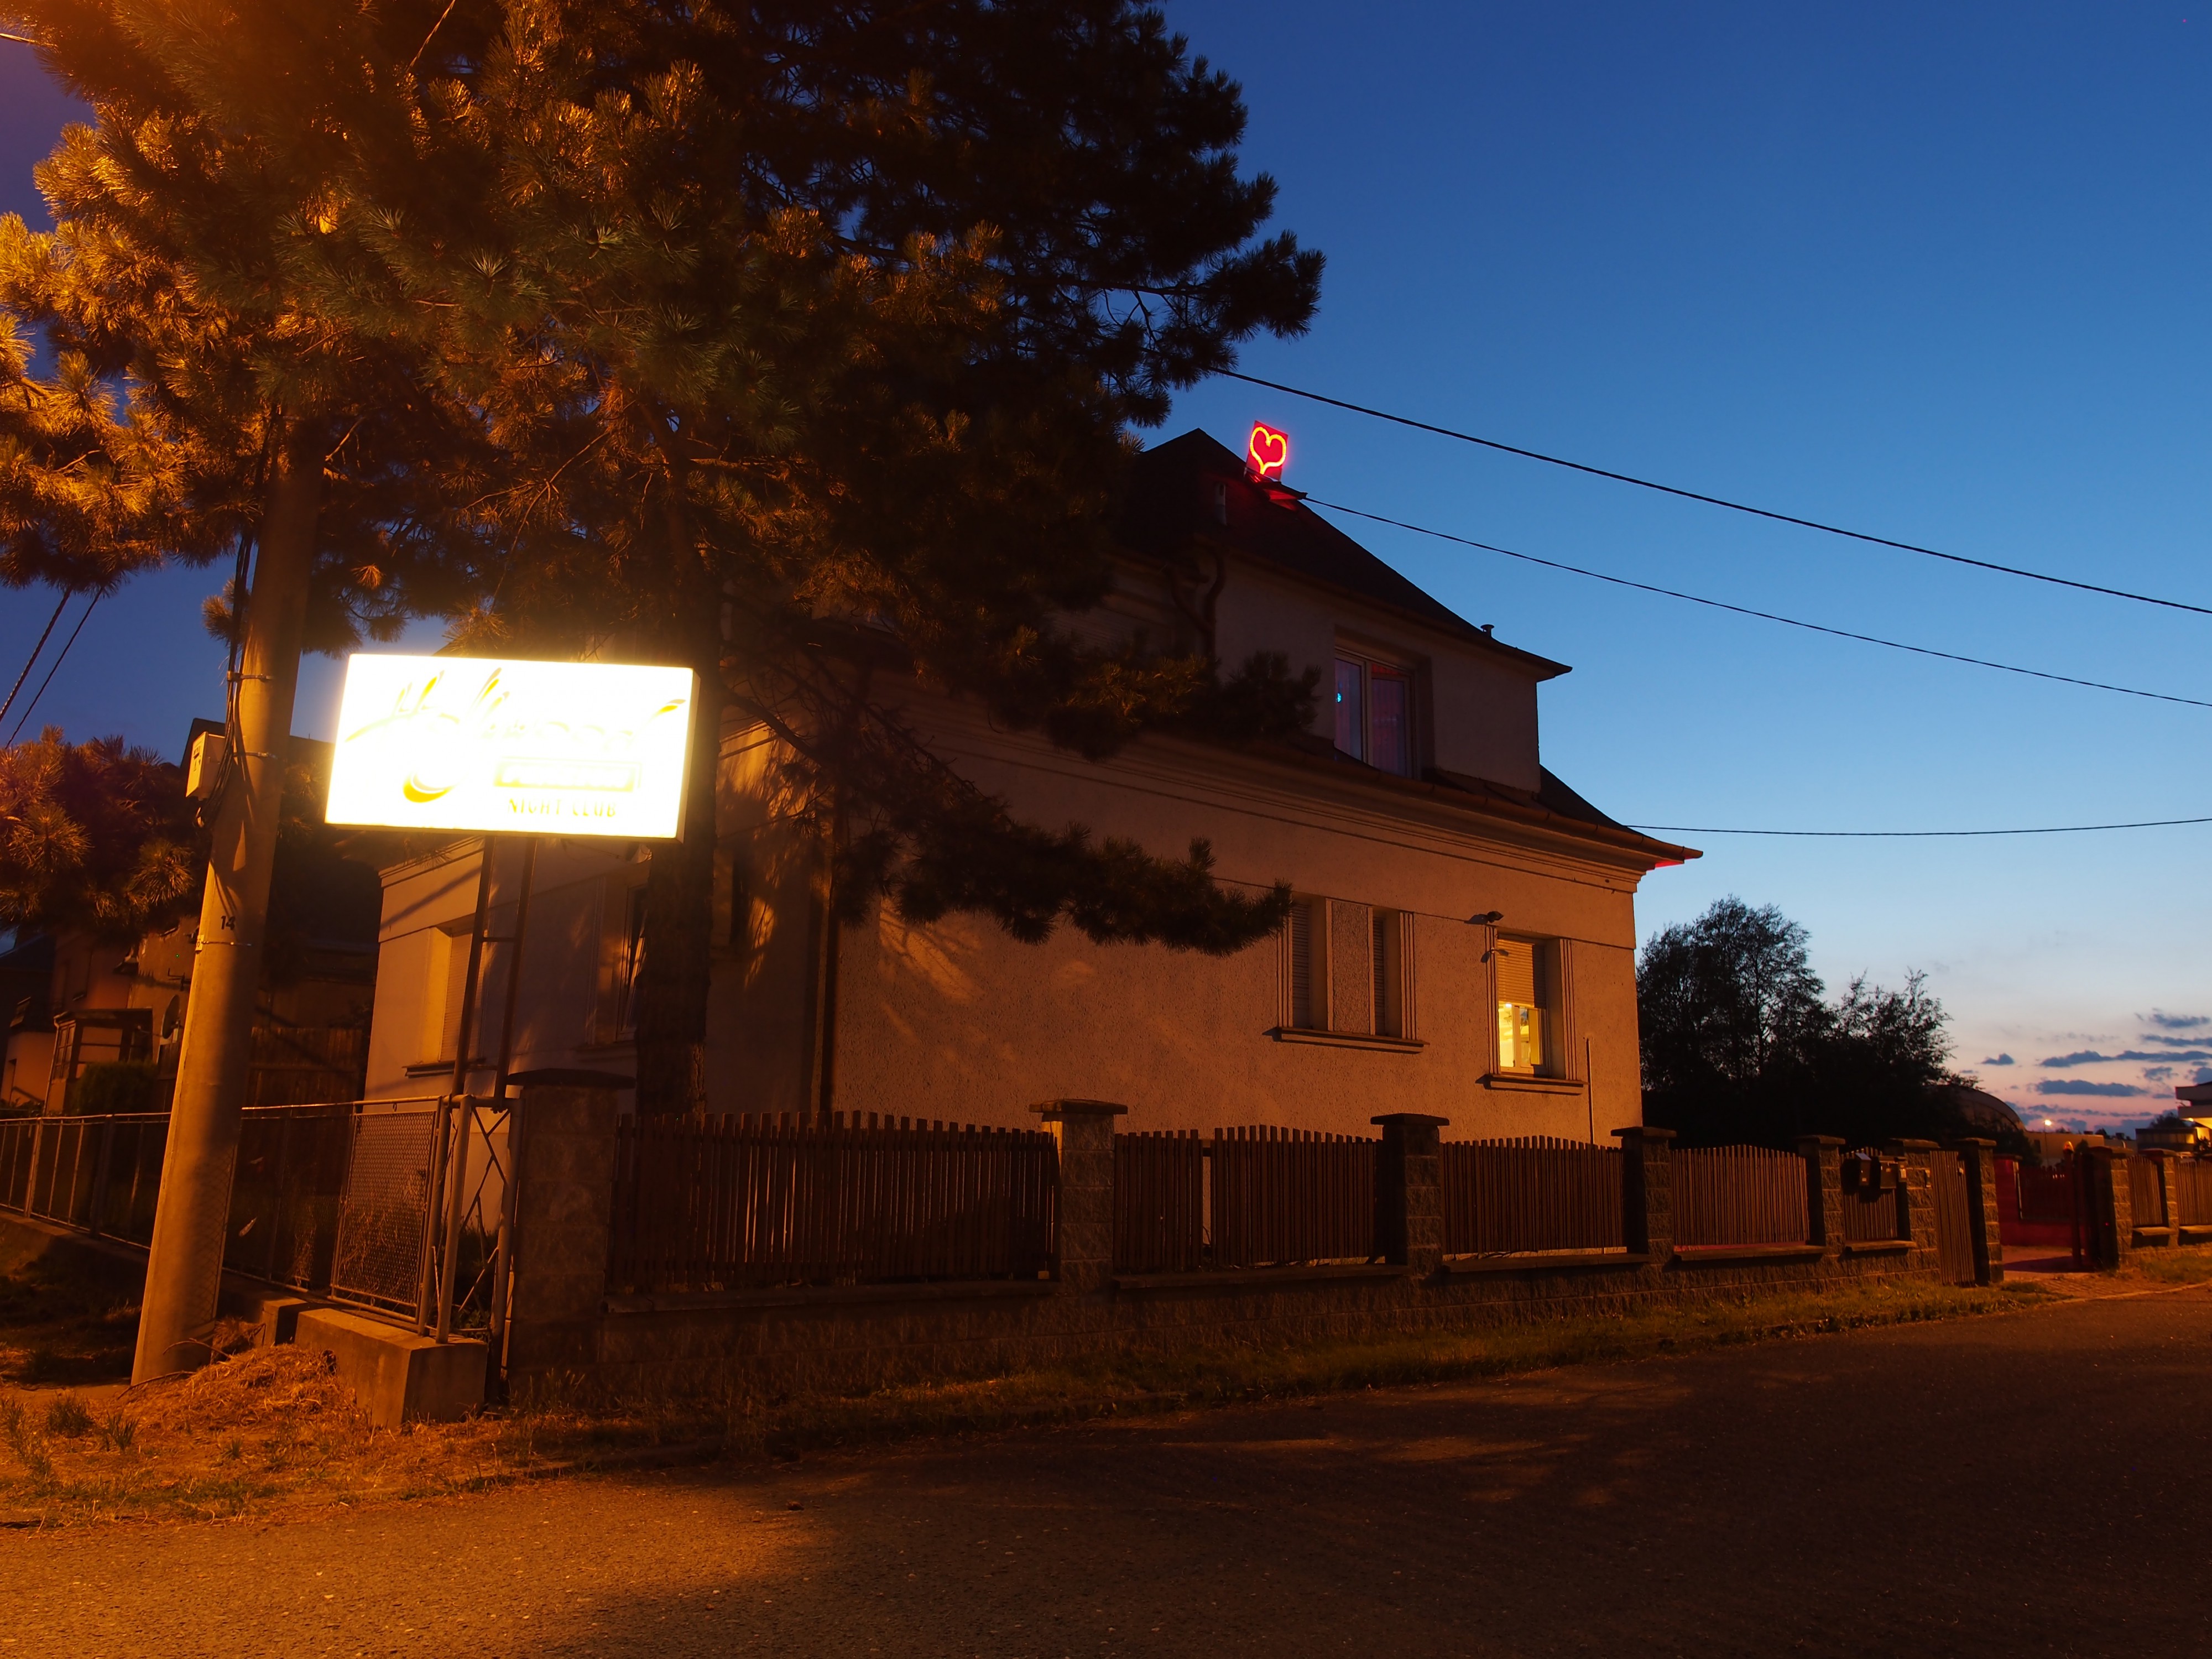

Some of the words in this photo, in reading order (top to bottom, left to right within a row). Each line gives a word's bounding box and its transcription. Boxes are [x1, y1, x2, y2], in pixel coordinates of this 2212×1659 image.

[508, 798, 561, 815] NIGHT
[572, 800, 615, 817] CLUB
[221, 916, 235, 930] 14
